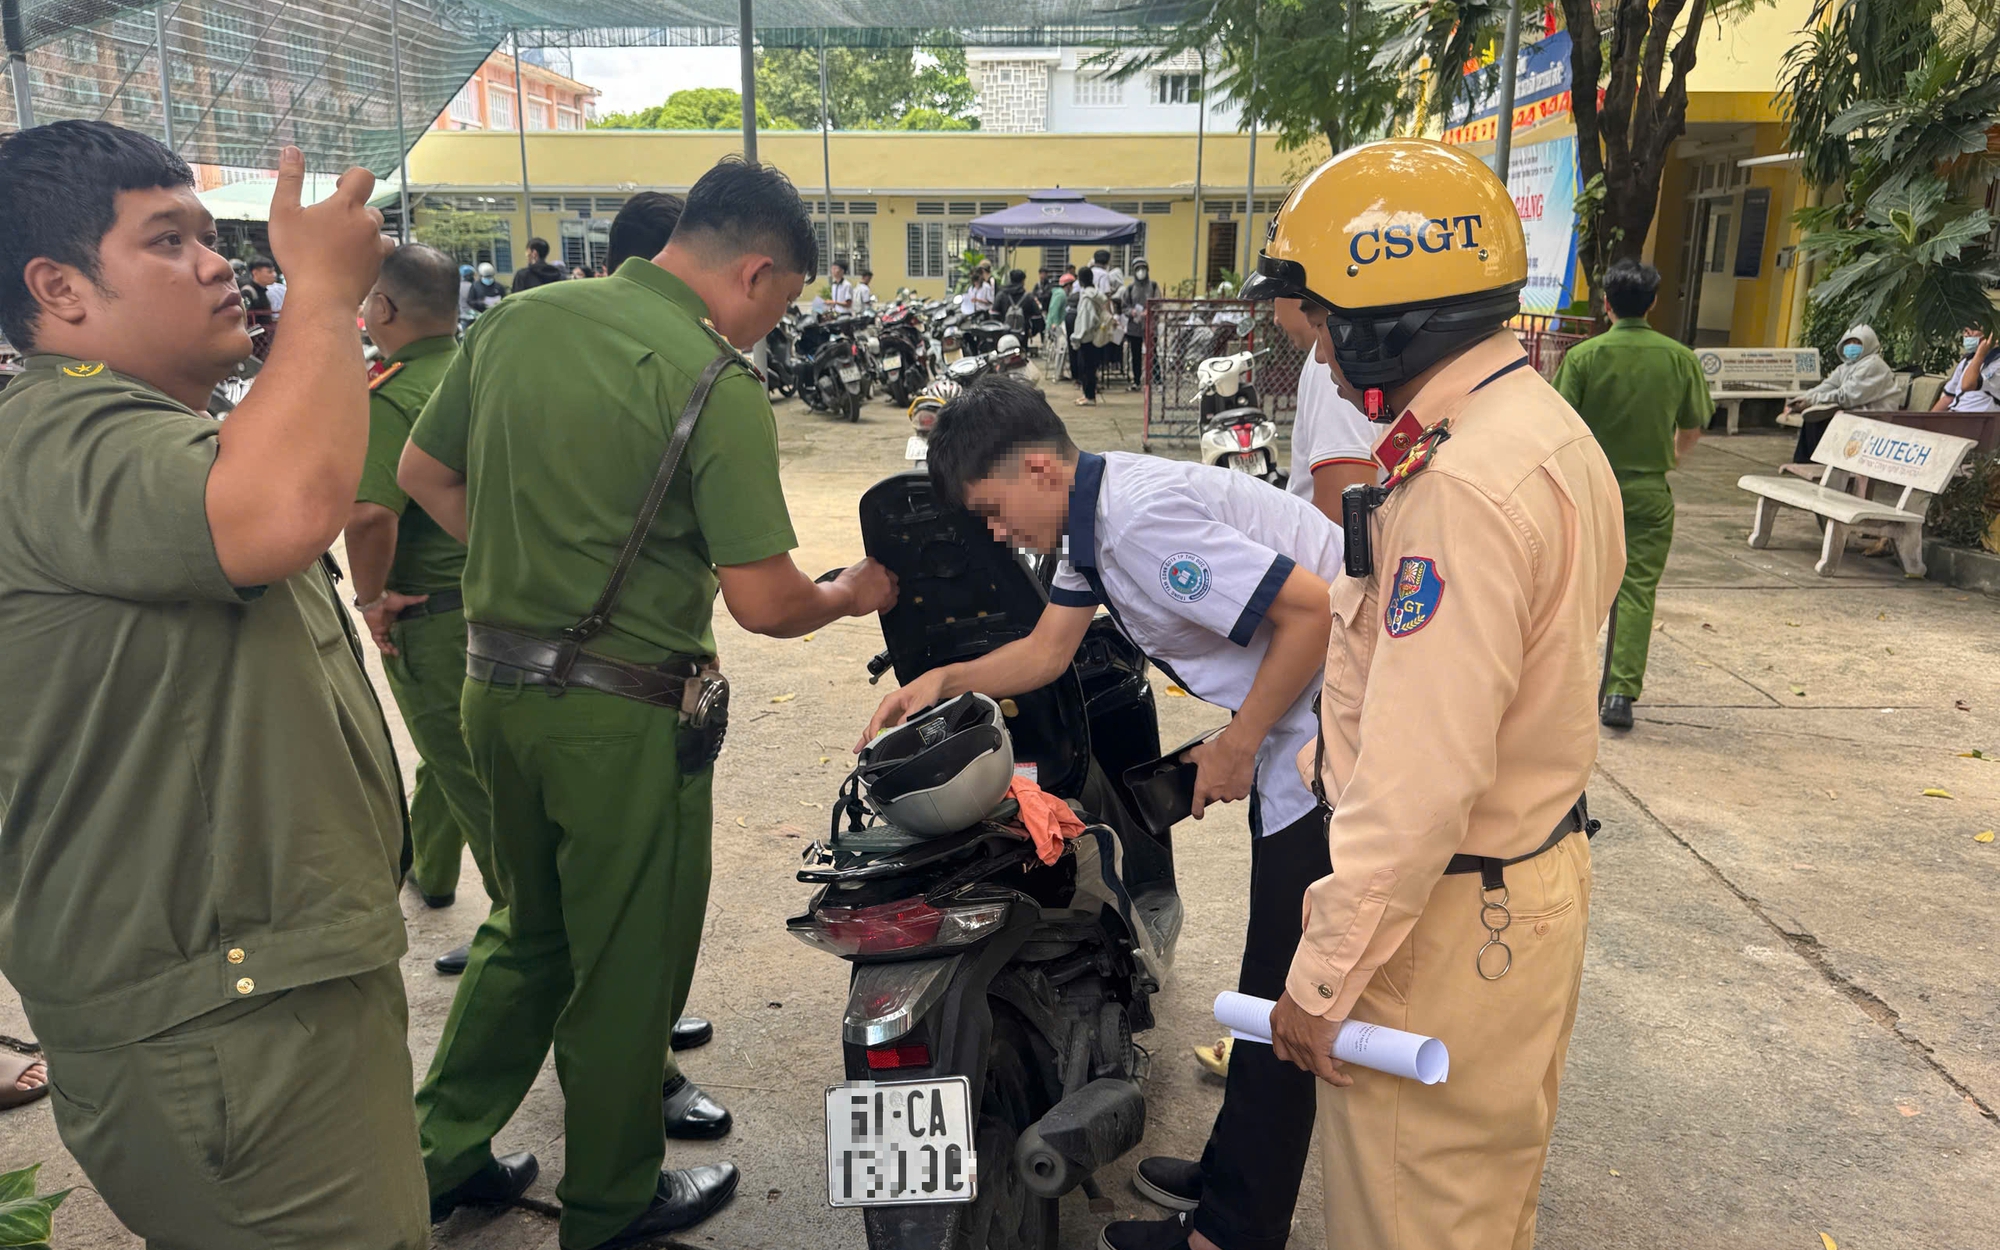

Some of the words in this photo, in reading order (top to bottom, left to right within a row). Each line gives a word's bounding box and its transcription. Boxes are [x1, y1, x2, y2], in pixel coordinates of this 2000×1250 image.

[1350, 215, 1482, 265] CSGT
[1862, 435, 1931, 466] HUTECH
[1403, 600, 1425, 615] GT
